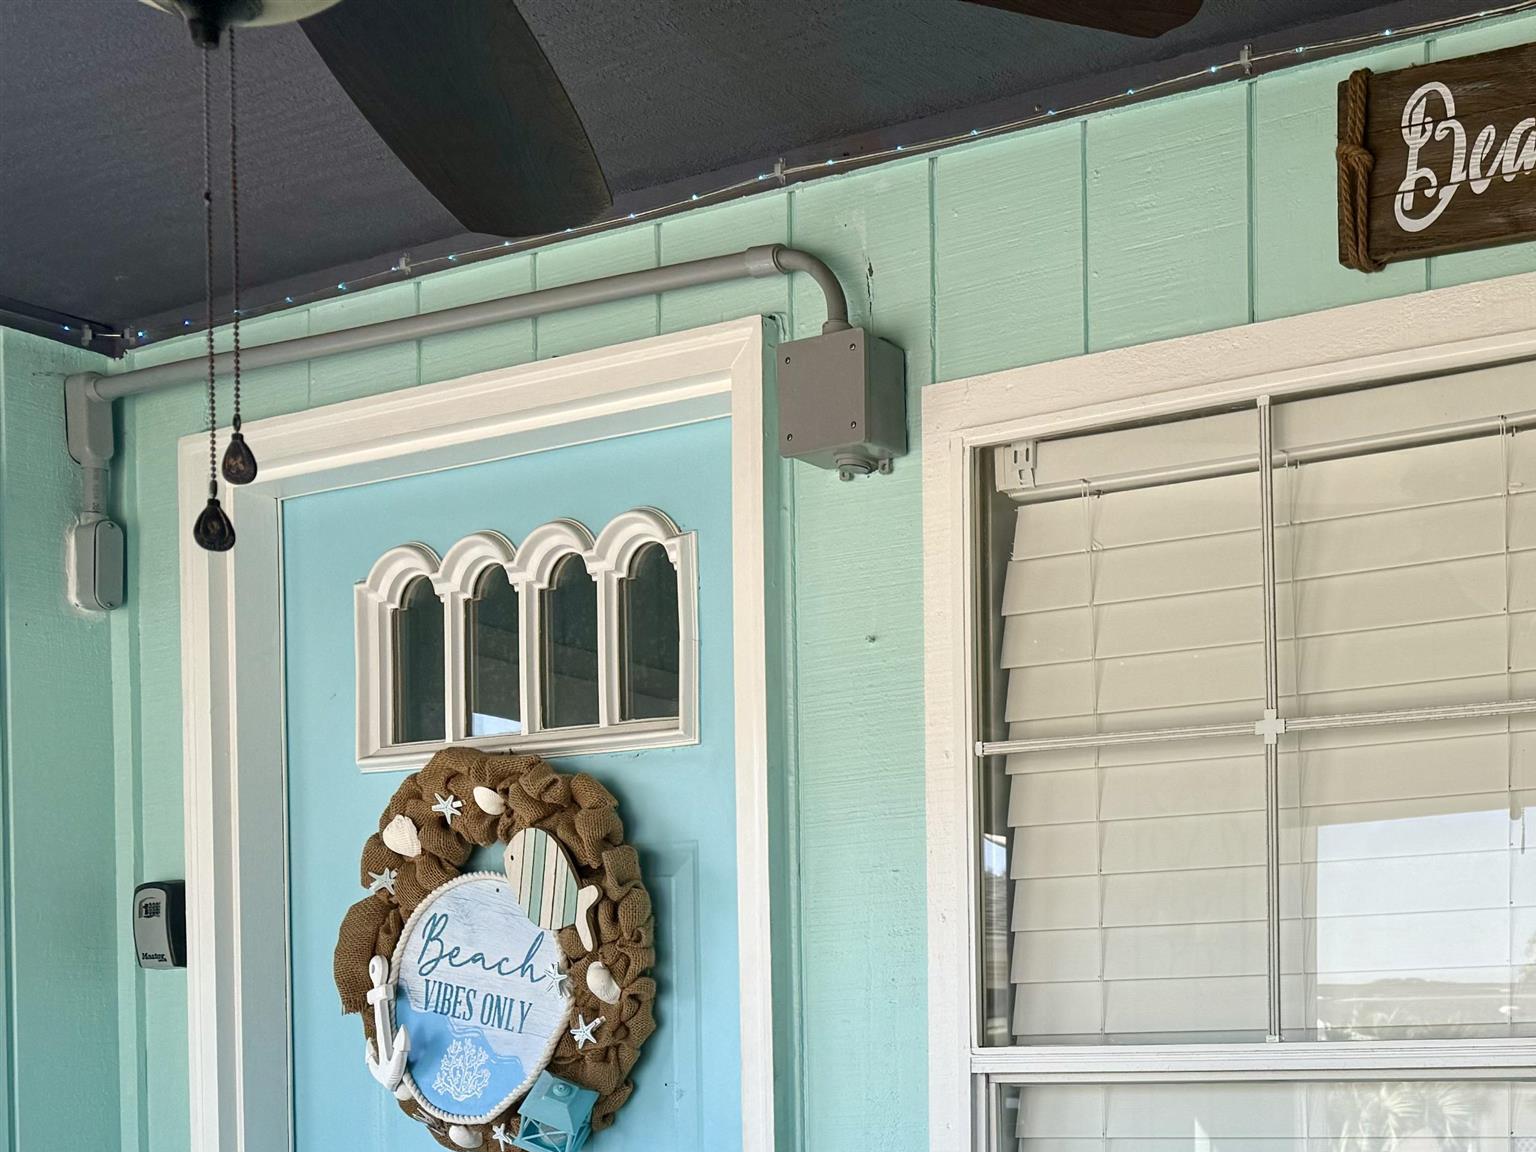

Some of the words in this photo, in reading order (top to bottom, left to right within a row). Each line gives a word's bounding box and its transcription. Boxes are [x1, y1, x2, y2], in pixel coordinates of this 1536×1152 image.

[417, 912, 548, 984] Beach
[424, 978, 477, 1021] VIBES
[480, 993, 533, 1034] ONLY
